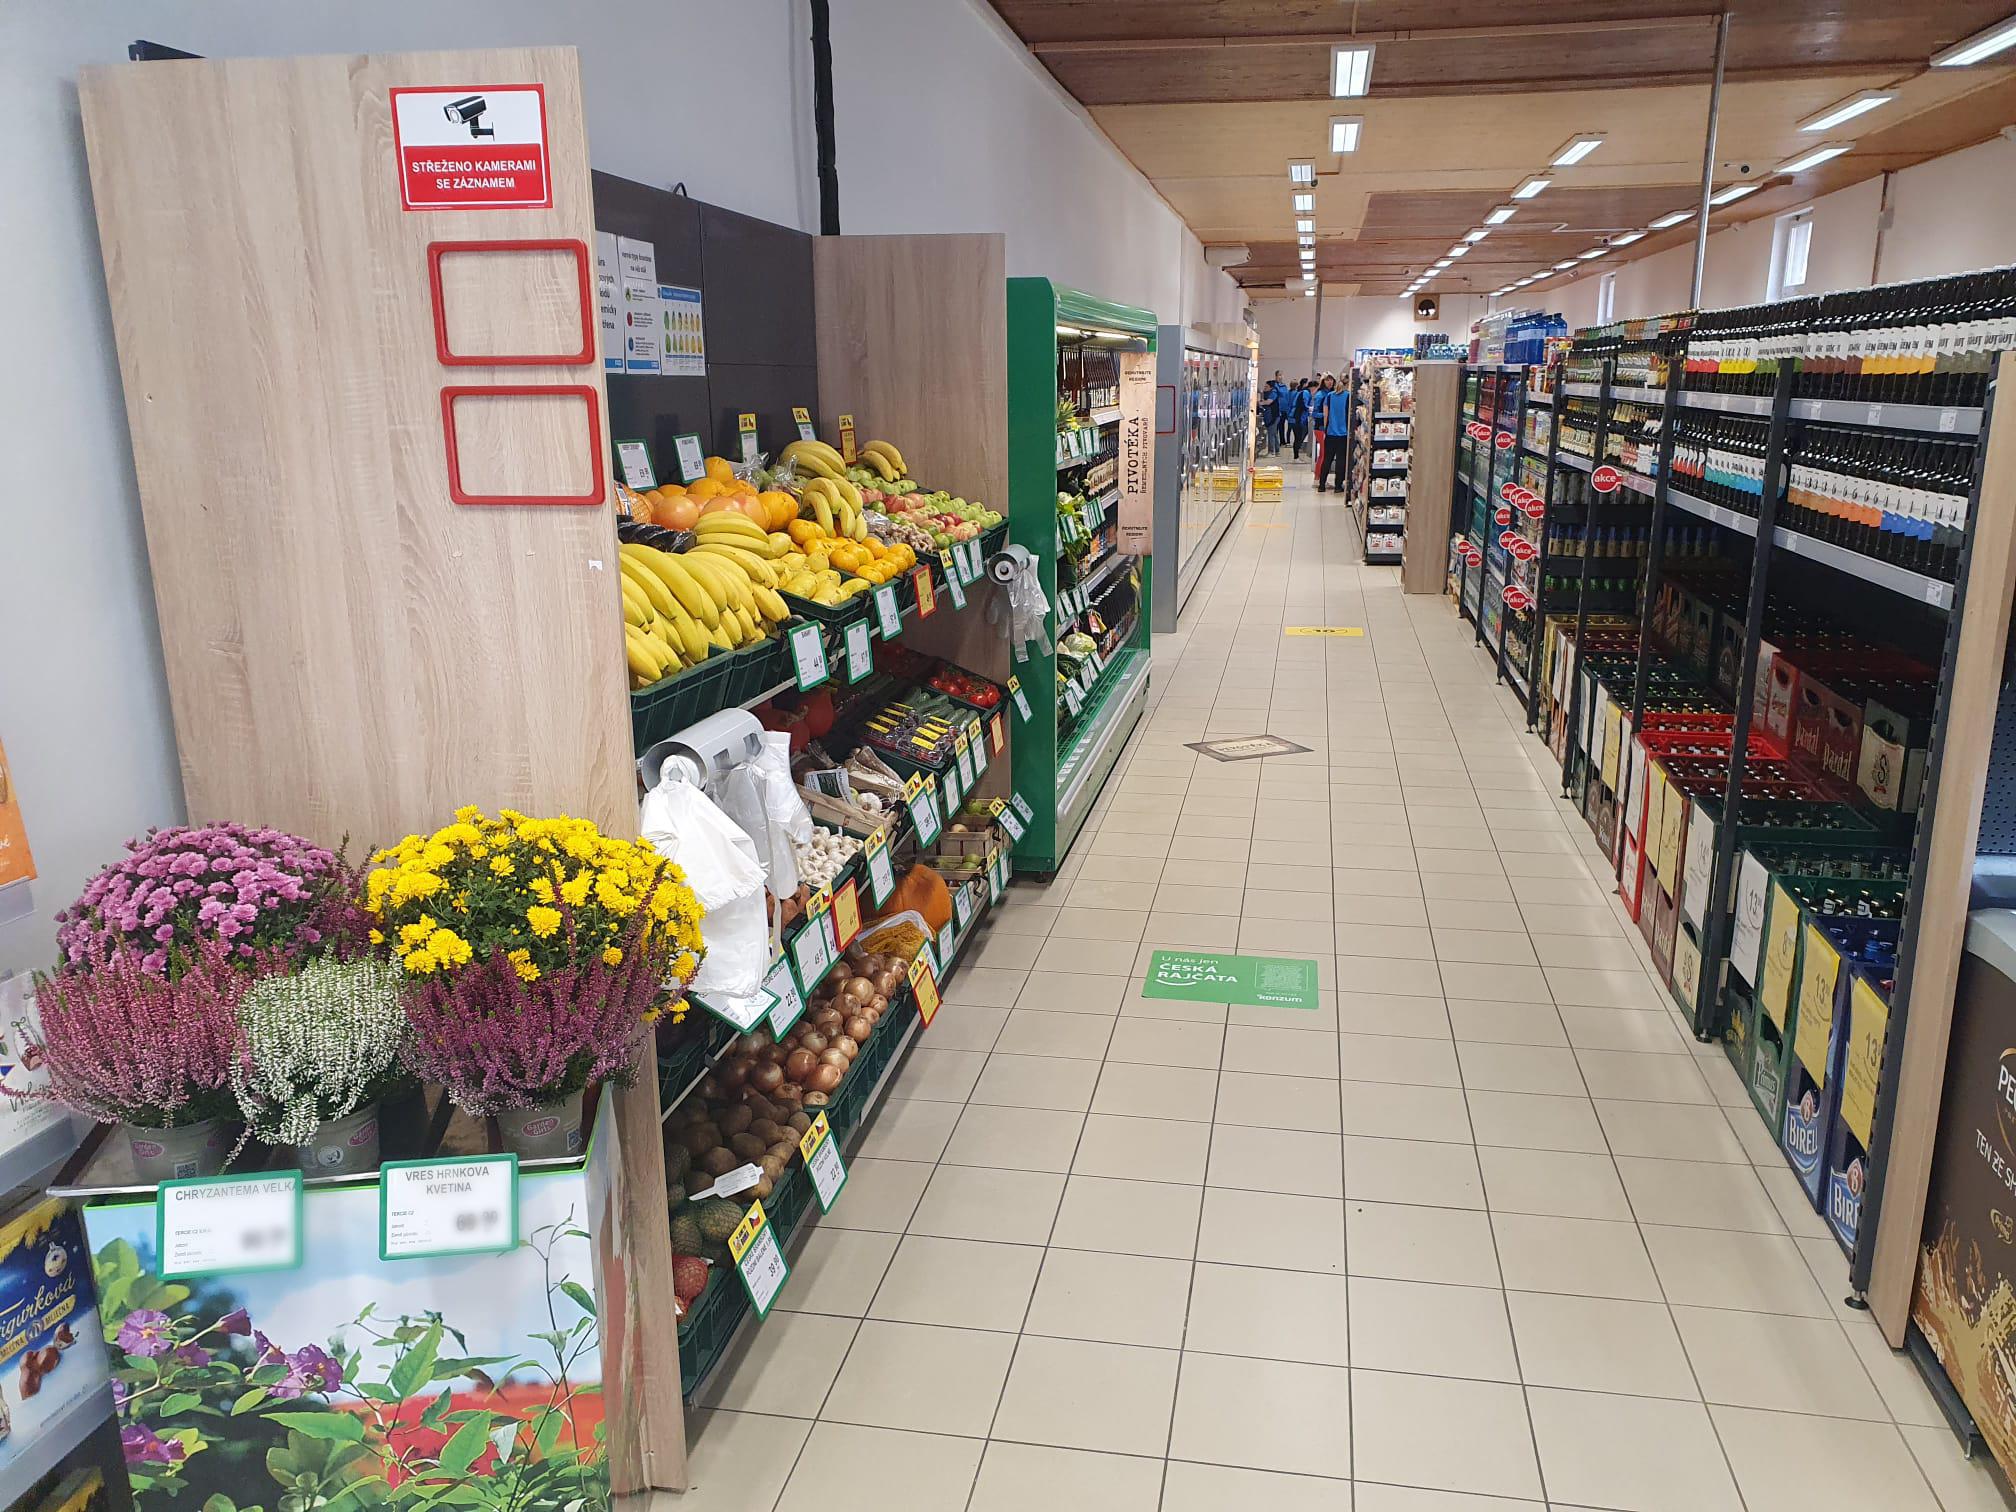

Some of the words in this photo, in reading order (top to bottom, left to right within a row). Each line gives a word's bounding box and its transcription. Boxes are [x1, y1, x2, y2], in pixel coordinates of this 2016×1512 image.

[412, 159, 473, 173] STŘEŽENO
[475, 159, 536, 172] KAMERAMI
[436, 178, 451, 189] SE
[453, 175, 515, 189] ZÁZNAMEM
[1123, 416, 1139, 494] PIVOTÉKA
[1594, 474, 1617, 483] akce
[1157, 971, 1239, 984] RAJČATA
[1815, 973, 1825, 1006] 13
[1257, 994, 1303, 1003] konzum
[1866, 1031, 1878, 1067] 13
[1976, 1128, 1993, 1164] TEN
[406, 1169, 434, 1182] VRES
[437, 1166, 490, 1179] HRNKOVA
[175, 1186, 260, 1201] CHRYZANTEMA
[426, 1182, 472, 1195] KVETINA
[0, 1271, 76, 1341] igurková
